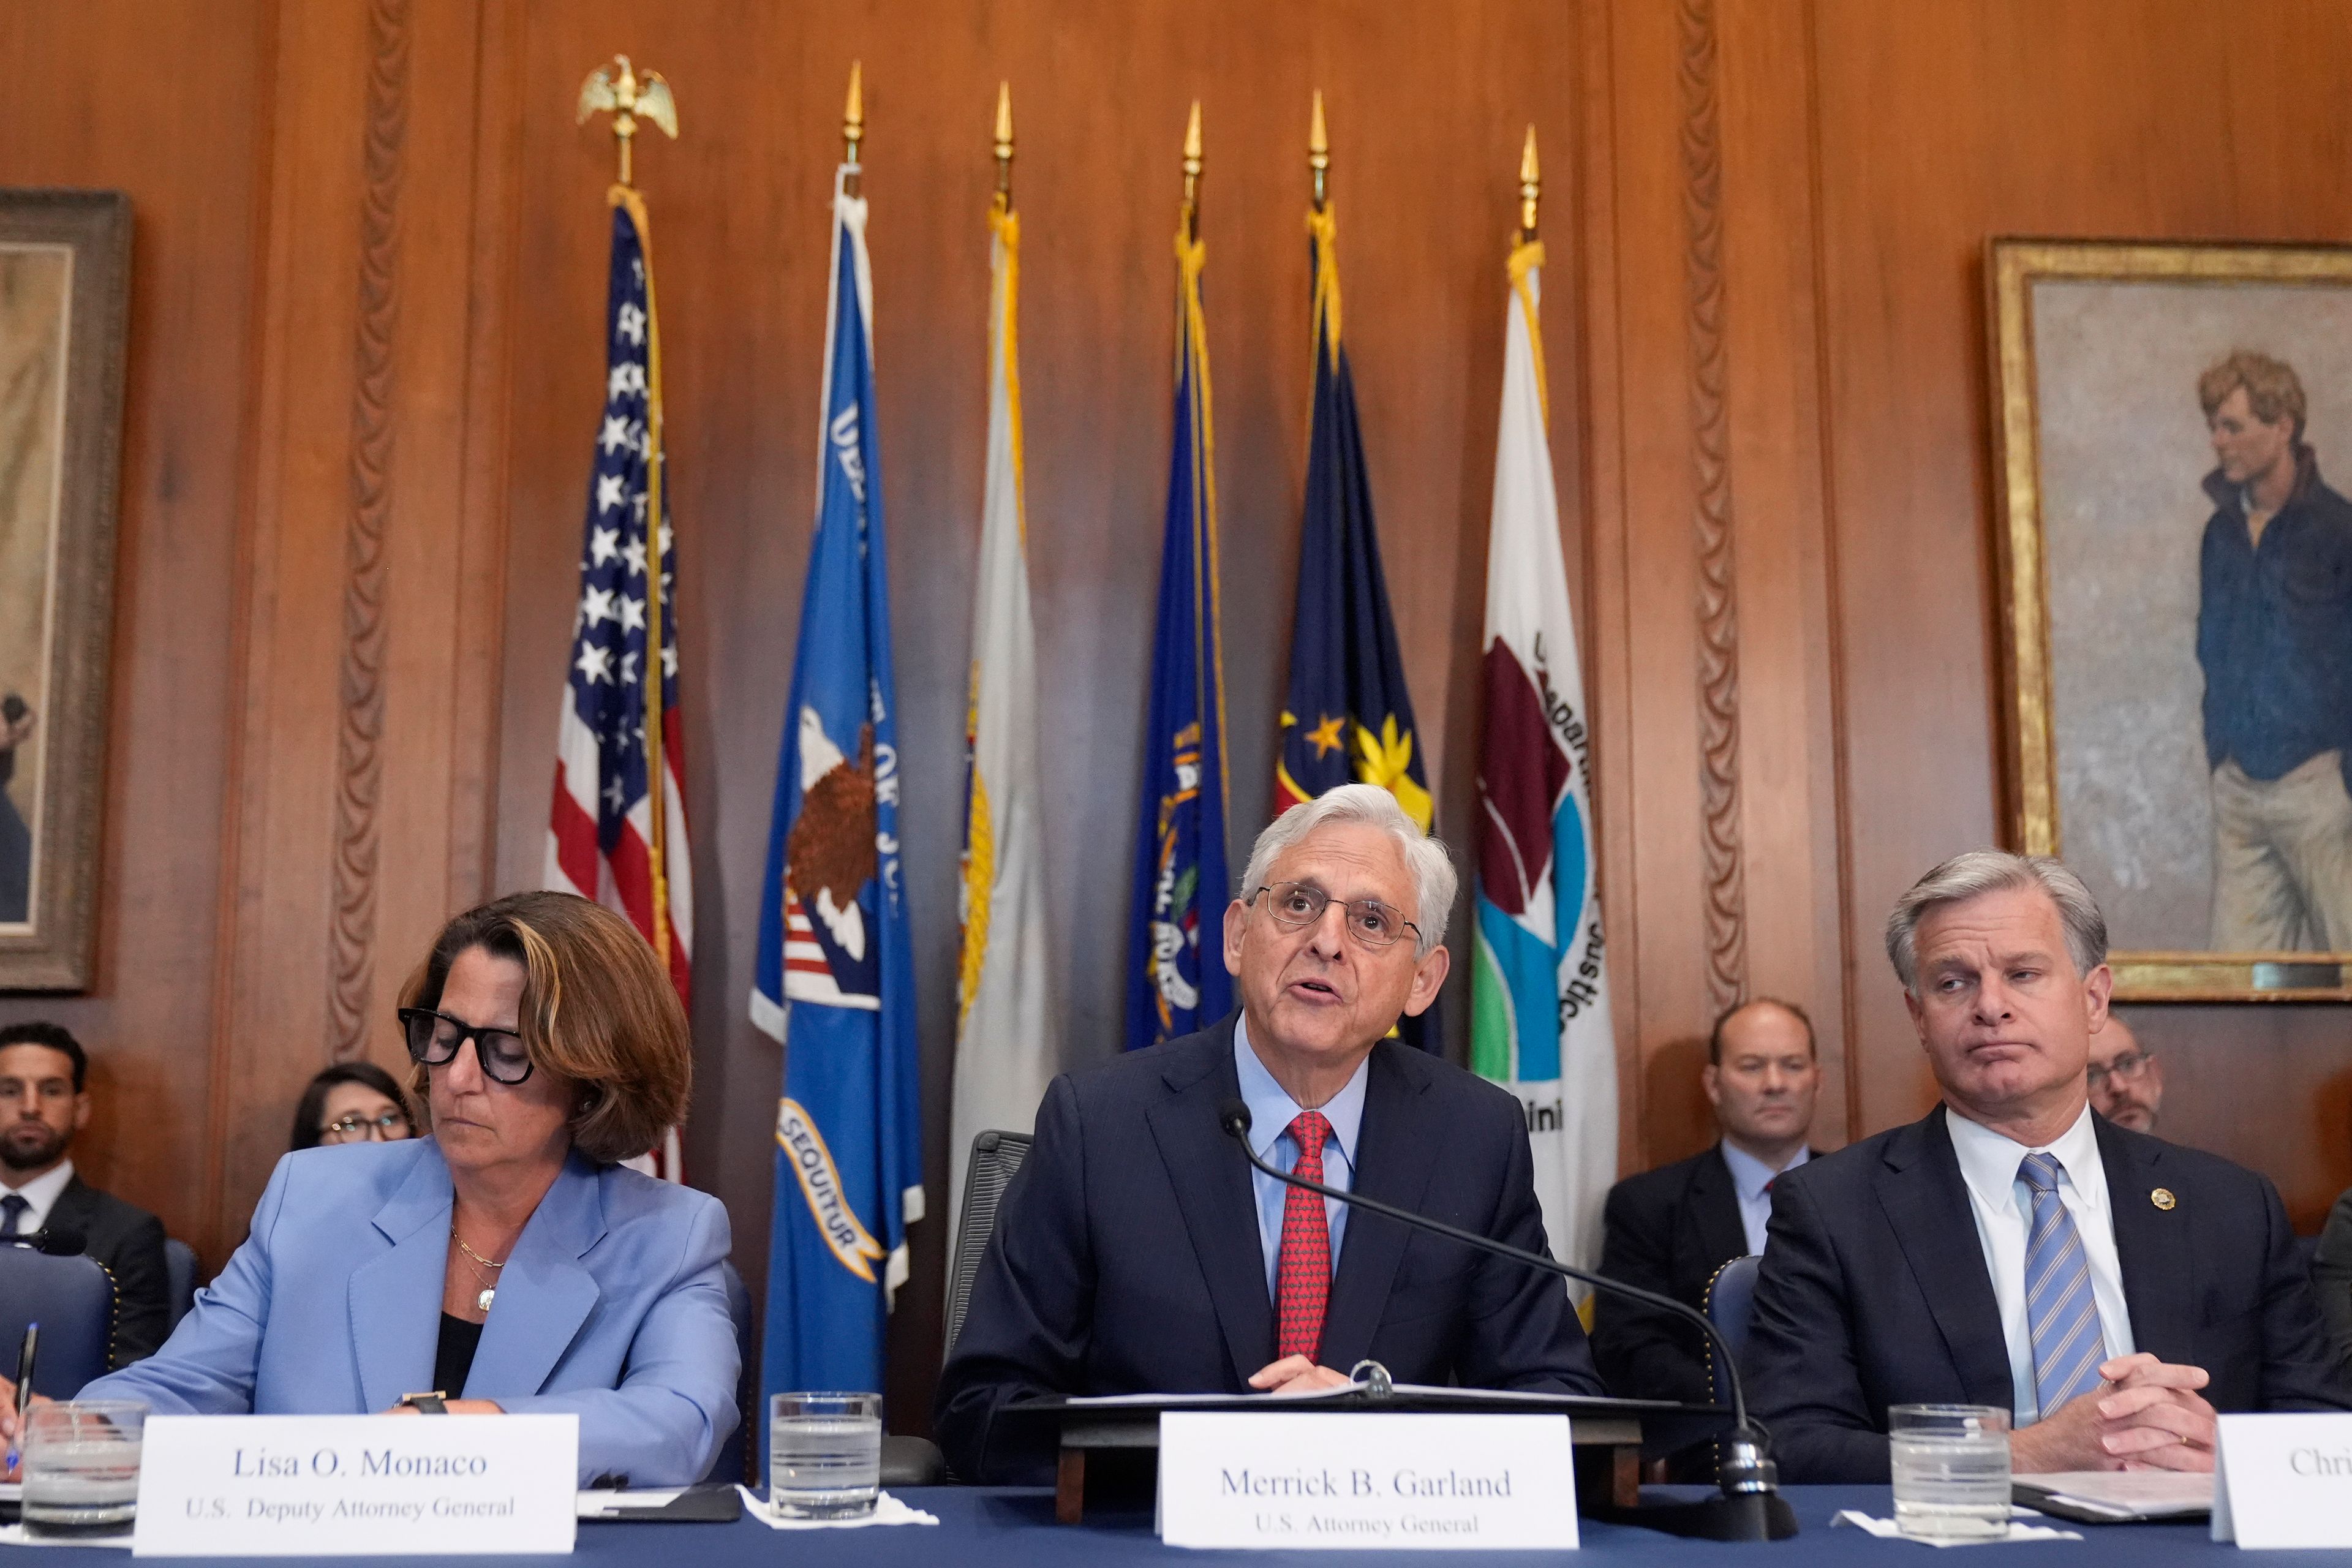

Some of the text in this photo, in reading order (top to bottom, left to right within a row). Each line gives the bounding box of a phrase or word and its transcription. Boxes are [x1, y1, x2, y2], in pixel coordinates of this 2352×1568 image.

[778, 1117, 856, 1248] SEQUITUR
[232, 1447, 488, 1478] Lisa O. Monaco
[2290, 1447, 2352, 1476] Chri
[1220, 1467, 1512, 1499] Merrick B. Garland
[184, 1495, 514, 1524] U.S. Deputy Attorney General
[1254, 1512, 1480, 1538] U.S. Attorney General
